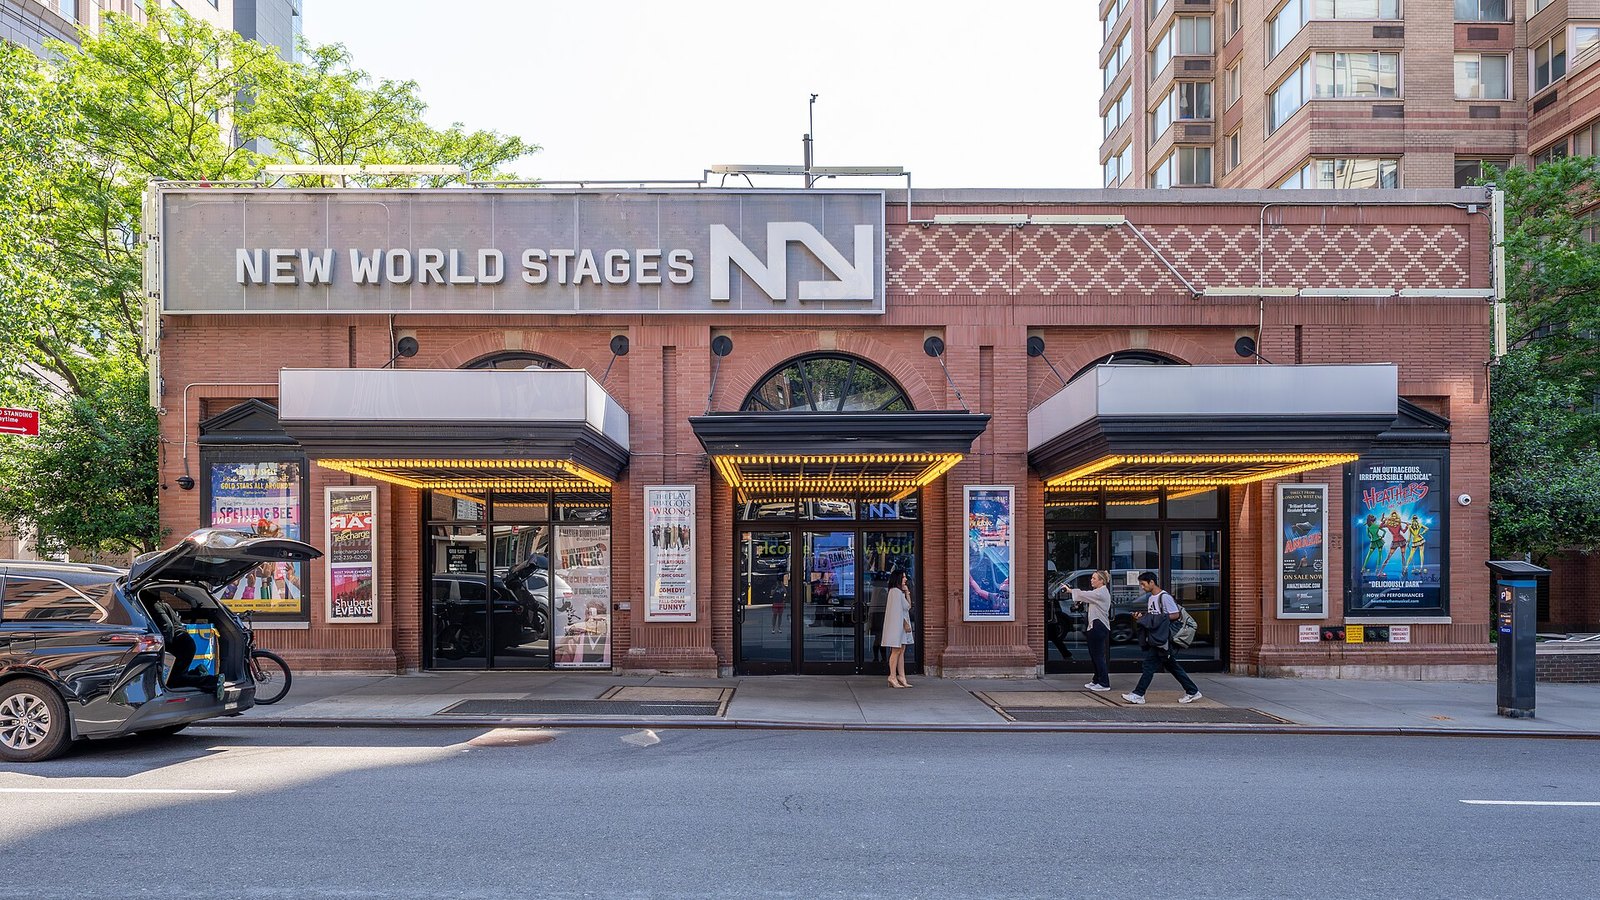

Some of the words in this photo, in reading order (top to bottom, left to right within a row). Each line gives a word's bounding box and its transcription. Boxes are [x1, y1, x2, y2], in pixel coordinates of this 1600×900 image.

[236, 248, 333, 285] NEW
[350, 248, 505, 285] WORLD
[521, 248, 694, 286] STAGES
[4, 410, 33, 418] STANDING
[1382, 466, 1421, 474] OUTRAGEOUS,
[1359, 473, 1403, 481] IRREPRESSIBLE
[1404, 473, 1432, 481] MUSICAL"
[350, 493, 369, 502] SHOW
[668, 492, 688, 500] PLAY
[1363, 482, 1429, 510] HEATHERS
[669, 499, 691, 507] GOES
[220, 507, 270, 520] SPELLING
[273, 507, 293, 519] BEE
[652, 507, 691, 517] WRONG
[333, 530, 370, 542] Telecharge
[1284, 531, 1323, 554] AMAZE
[1369, 580, 1404, 588] "DELICIOUSLY
[1405, 580, 1423, 588] DARK"
[335, 598, 372, 607] Shubert
[335, 606, 372, 615] EVENTS
